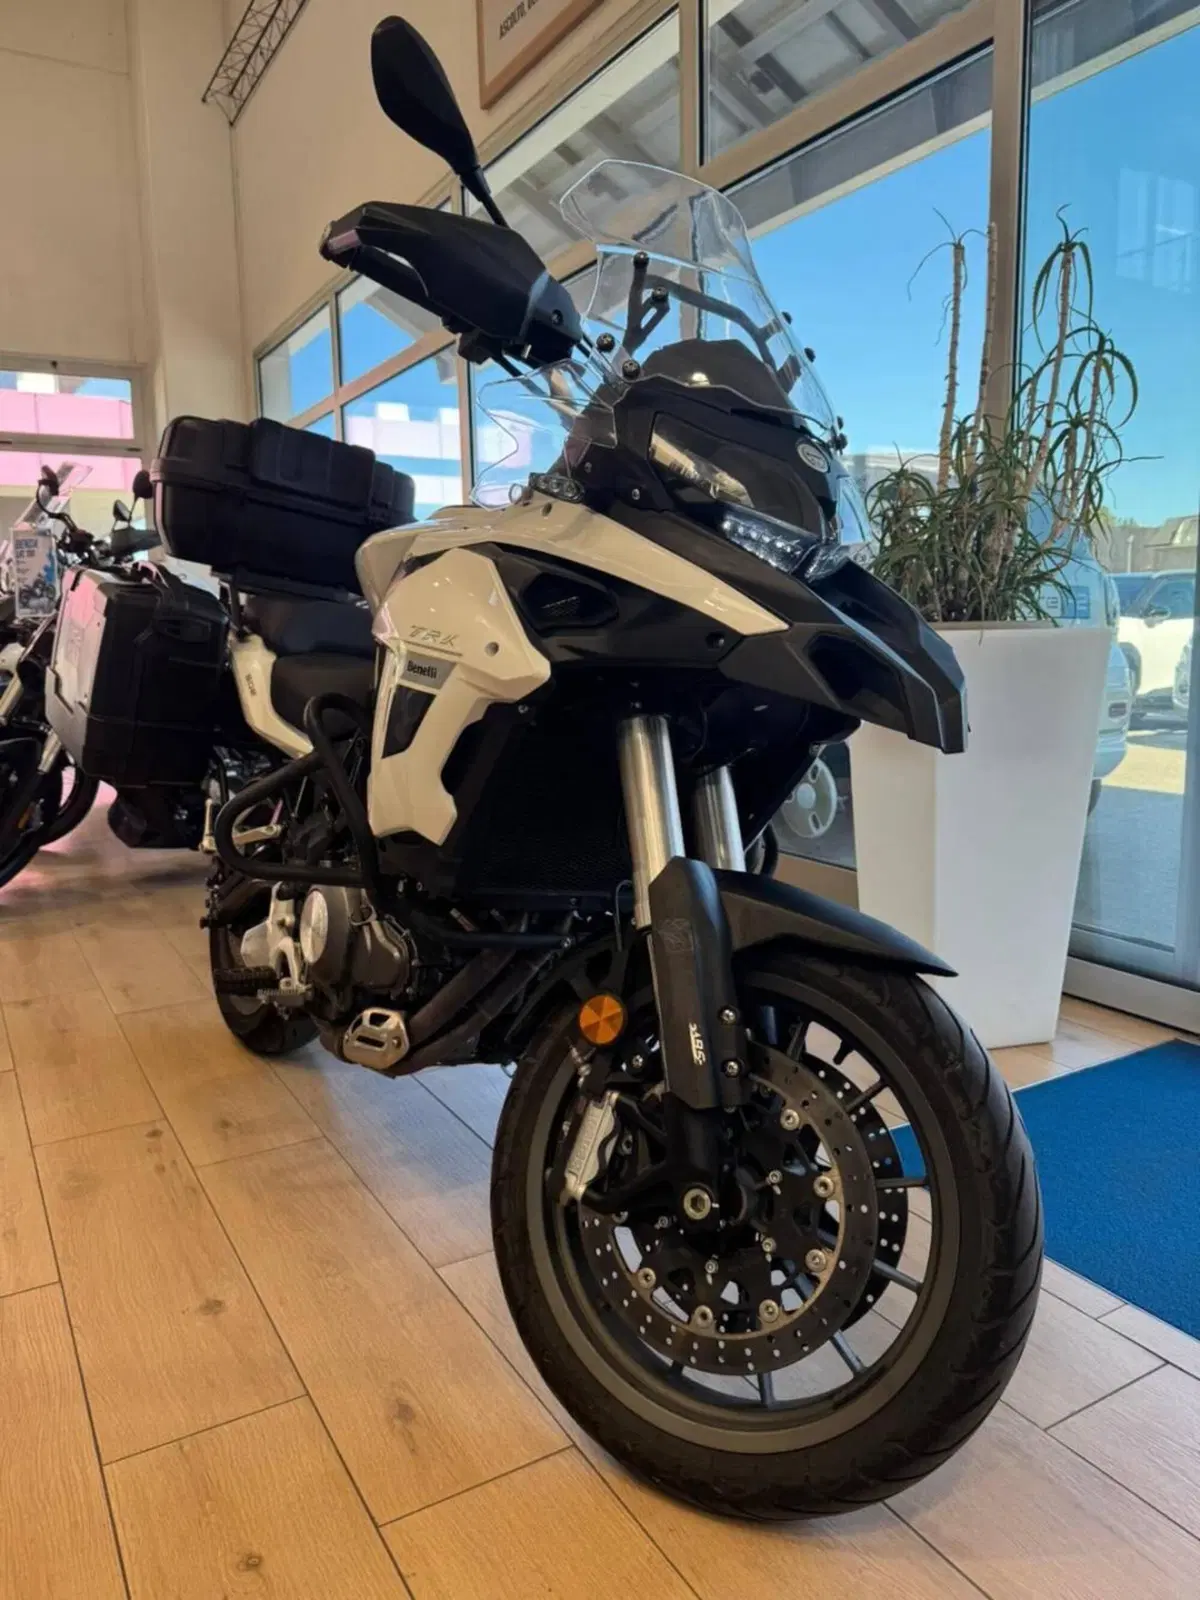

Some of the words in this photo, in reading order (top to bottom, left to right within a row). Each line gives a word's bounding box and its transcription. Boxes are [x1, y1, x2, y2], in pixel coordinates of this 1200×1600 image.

[409, 624, 460, 648] TRK
[407, 660, 438, 679] Benelli
[690, 1025, 706, 1064] ABS
